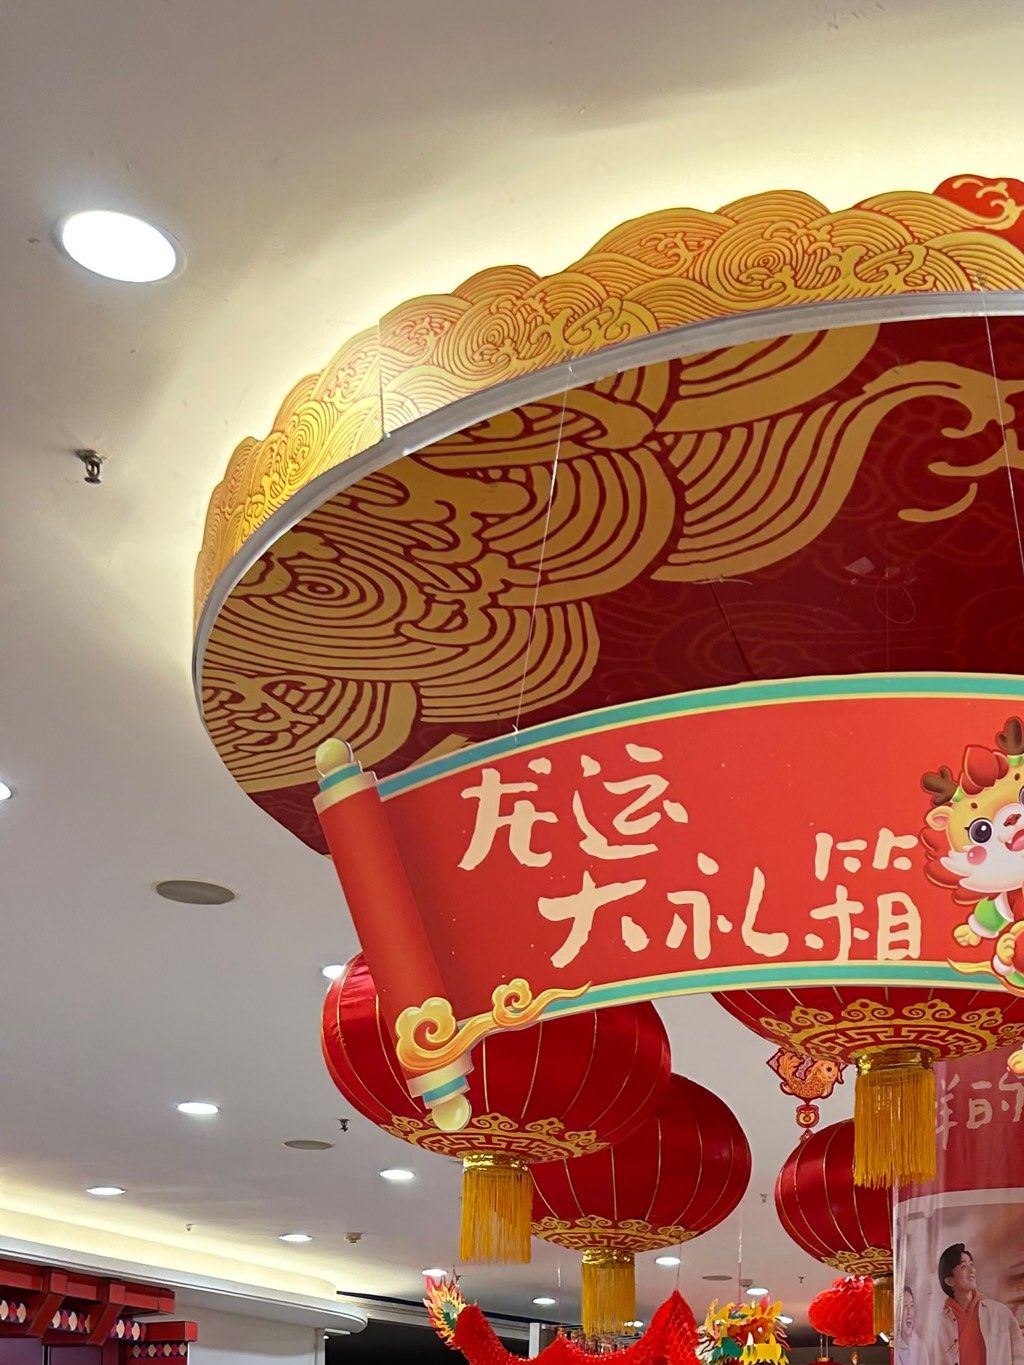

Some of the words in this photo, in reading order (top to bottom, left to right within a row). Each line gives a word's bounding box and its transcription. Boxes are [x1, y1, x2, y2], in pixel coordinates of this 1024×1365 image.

[456, 742, 690, 873] 龙运
[538, 832, 923, 968] 大礼箱
